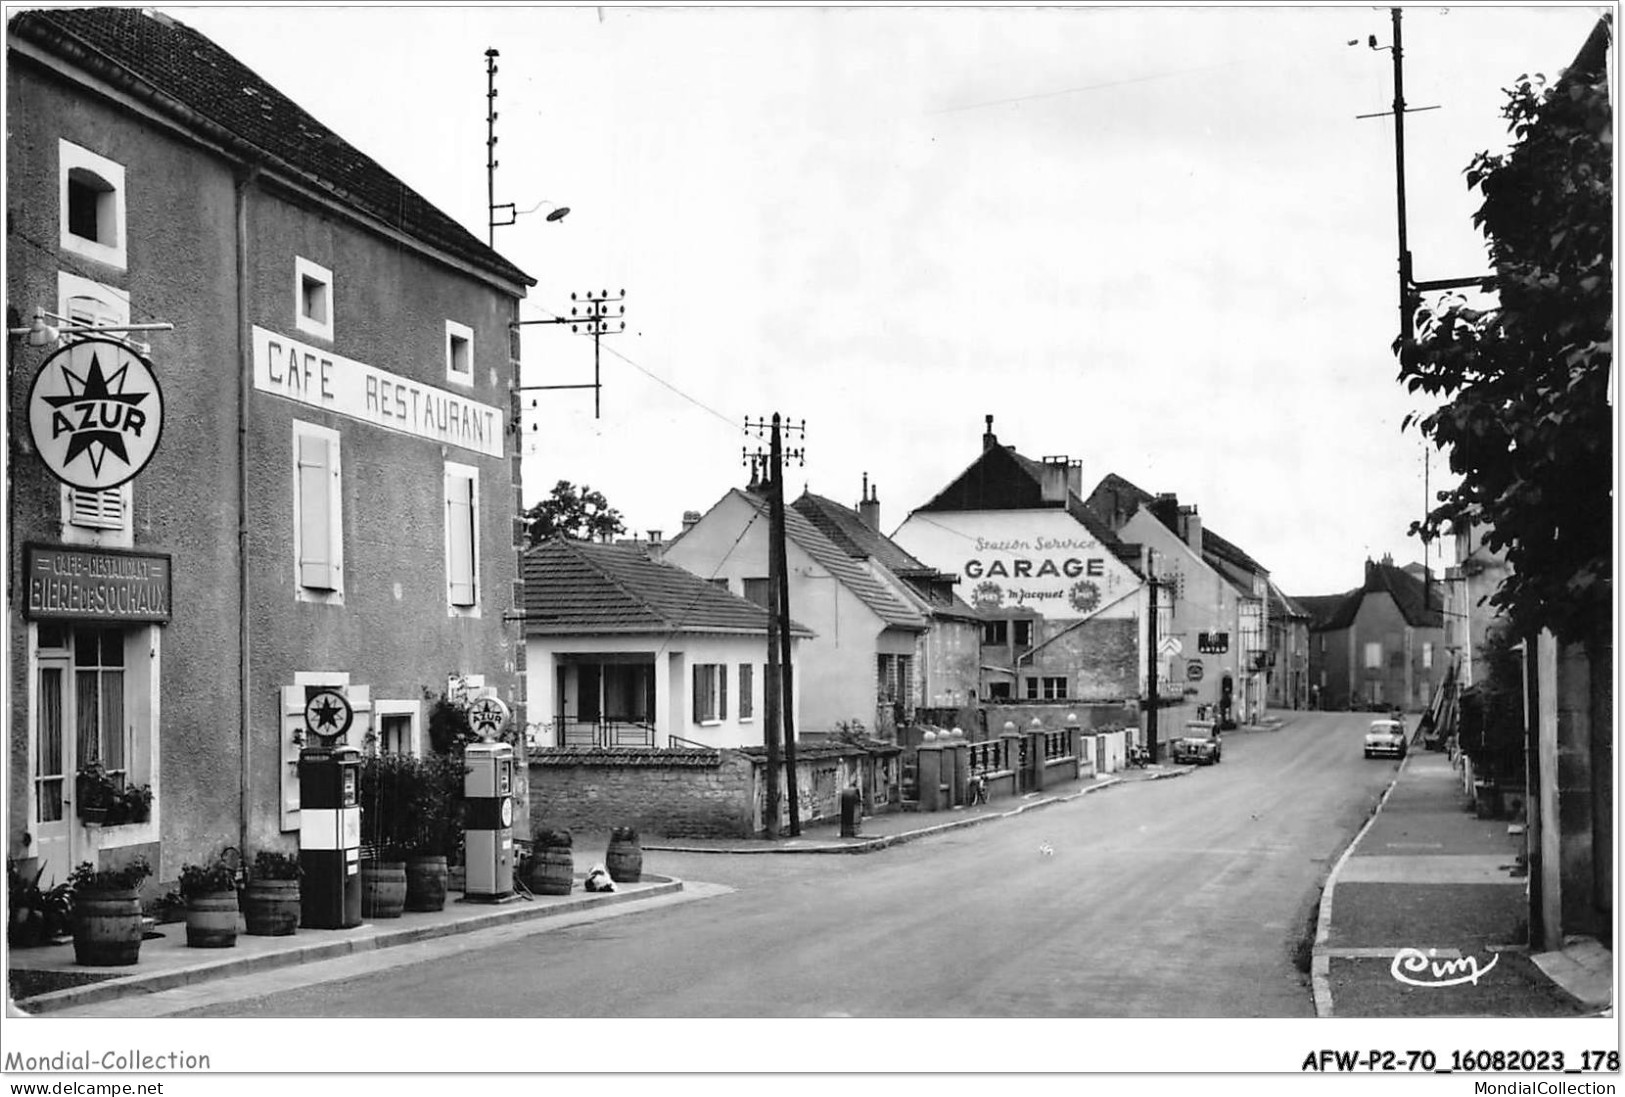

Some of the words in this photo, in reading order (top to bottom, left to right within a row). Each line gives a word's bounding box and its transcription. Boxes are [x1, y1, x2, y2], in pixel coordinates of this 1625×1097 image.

[268, 340, 334, 399] CAFE
[365, 374, 494, 446] RESTAURANT
[52, 402, 146, 440] AZUR
[975, 536, 1031, 551] Station
[1034, 536, 1097, 551] Service
[964, 558, 1104, 578] GARAGE
[95, 583, 168, 614] SOCHAUX
[473, 712, 502, 725] AZUR
